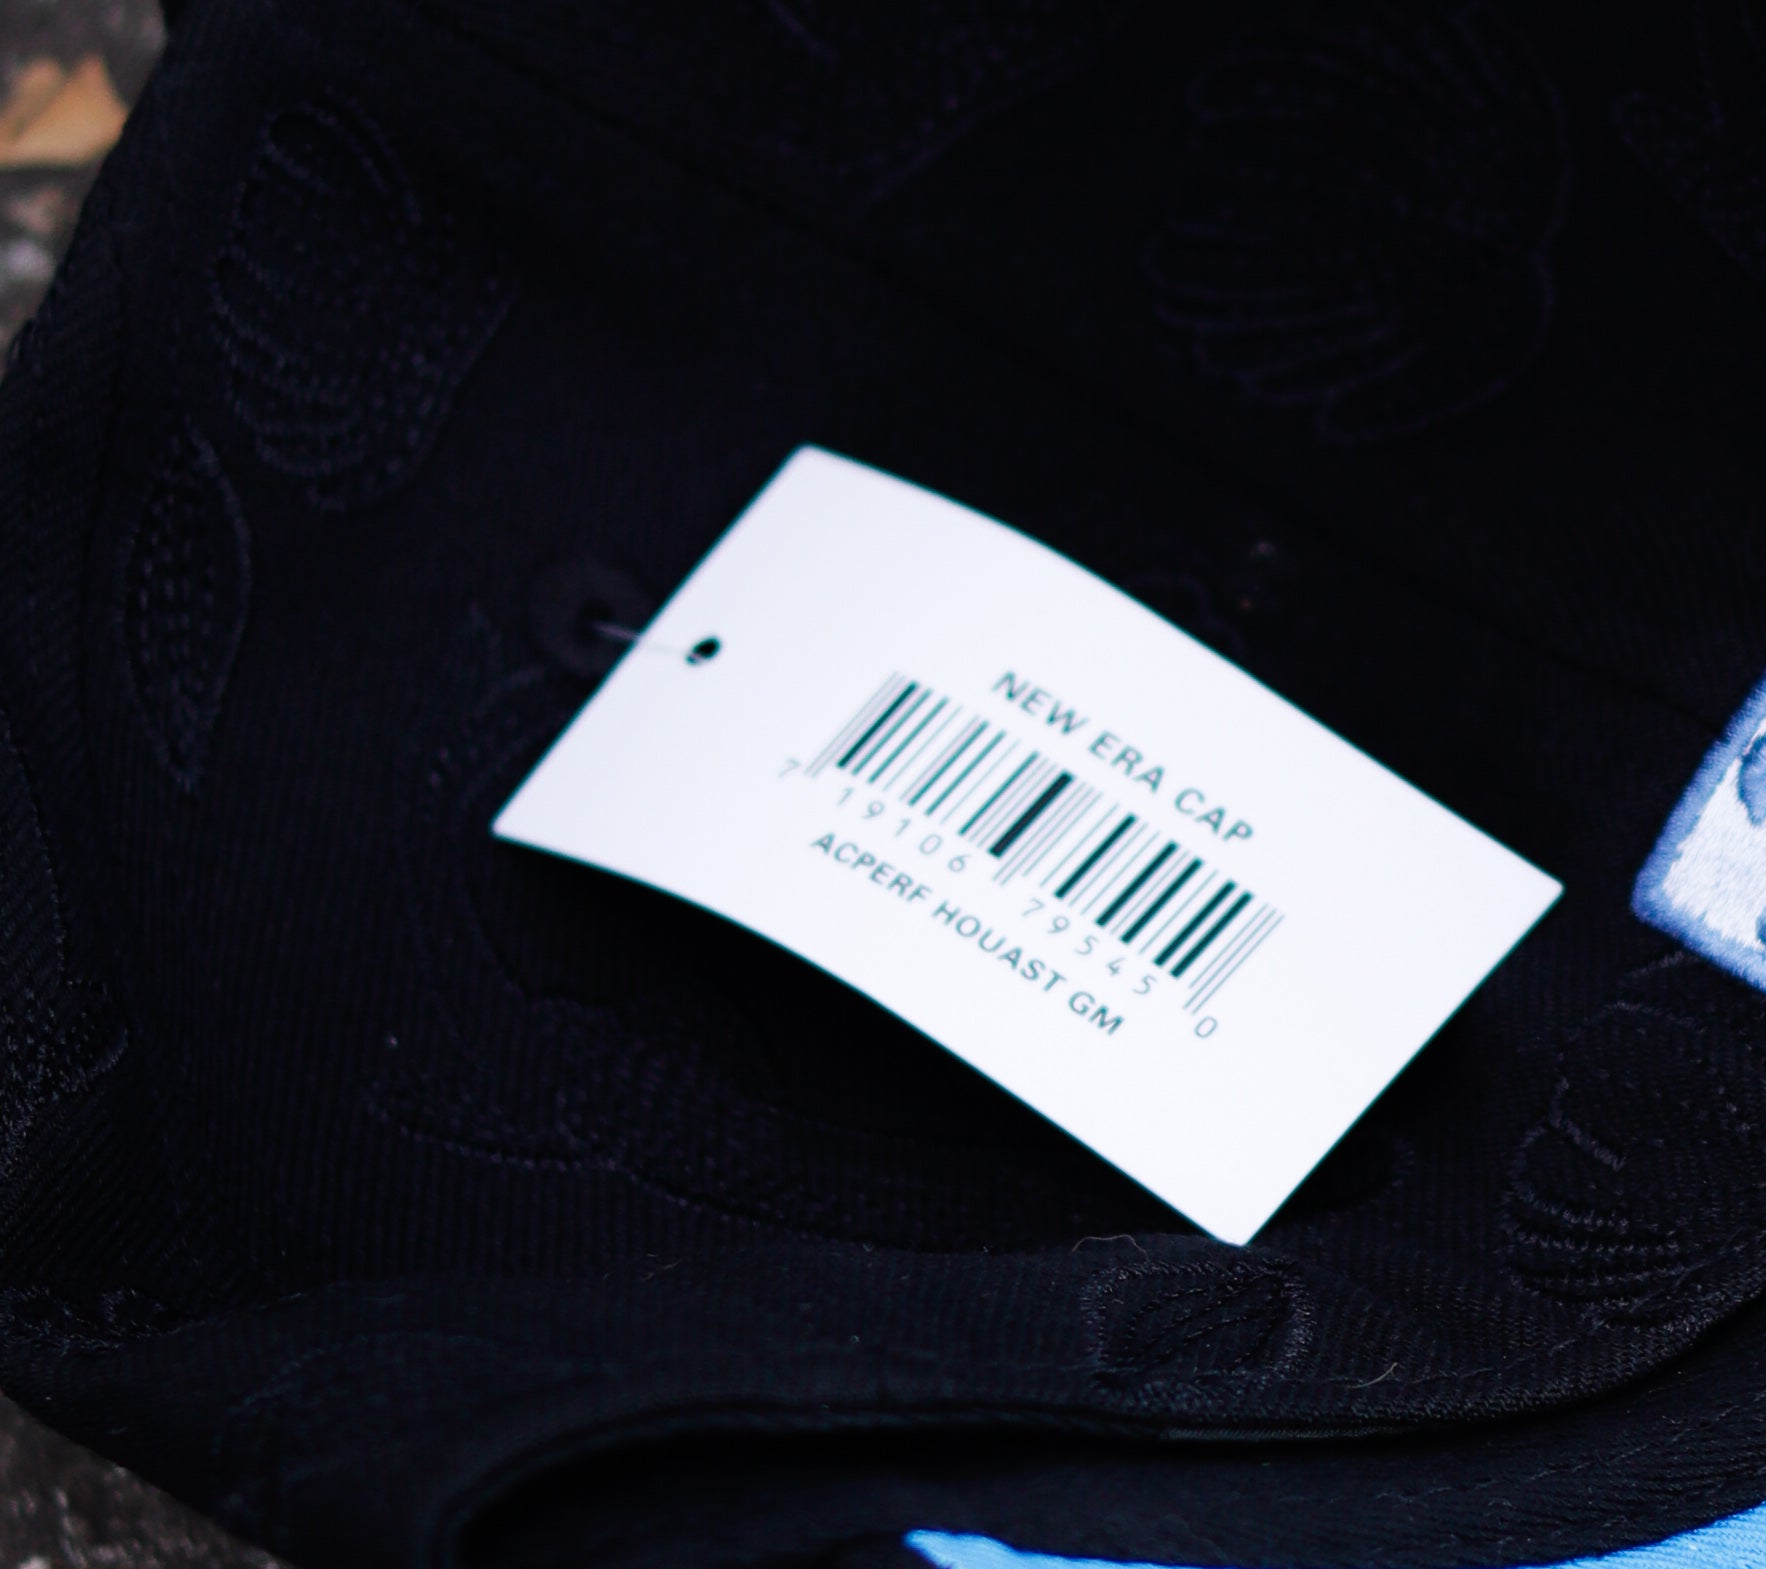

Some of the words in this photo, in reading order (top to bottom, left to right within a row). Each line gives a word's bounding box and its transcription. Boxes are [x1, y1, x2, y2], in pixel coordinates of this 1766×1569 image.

[991, 669, 1088, 736] NEW
[1087, 729, 1167, 795] ERA
[1172, 787, 1256, 843] CAP
[810, 831, 933, 904] ACPERF
[931, 900, 1067, 993] HOUAST
[1067, 990, 1126, 1036] GM
[836, 786, 973, 874] 19106
[1021, 898, 1159, 996] 79545
